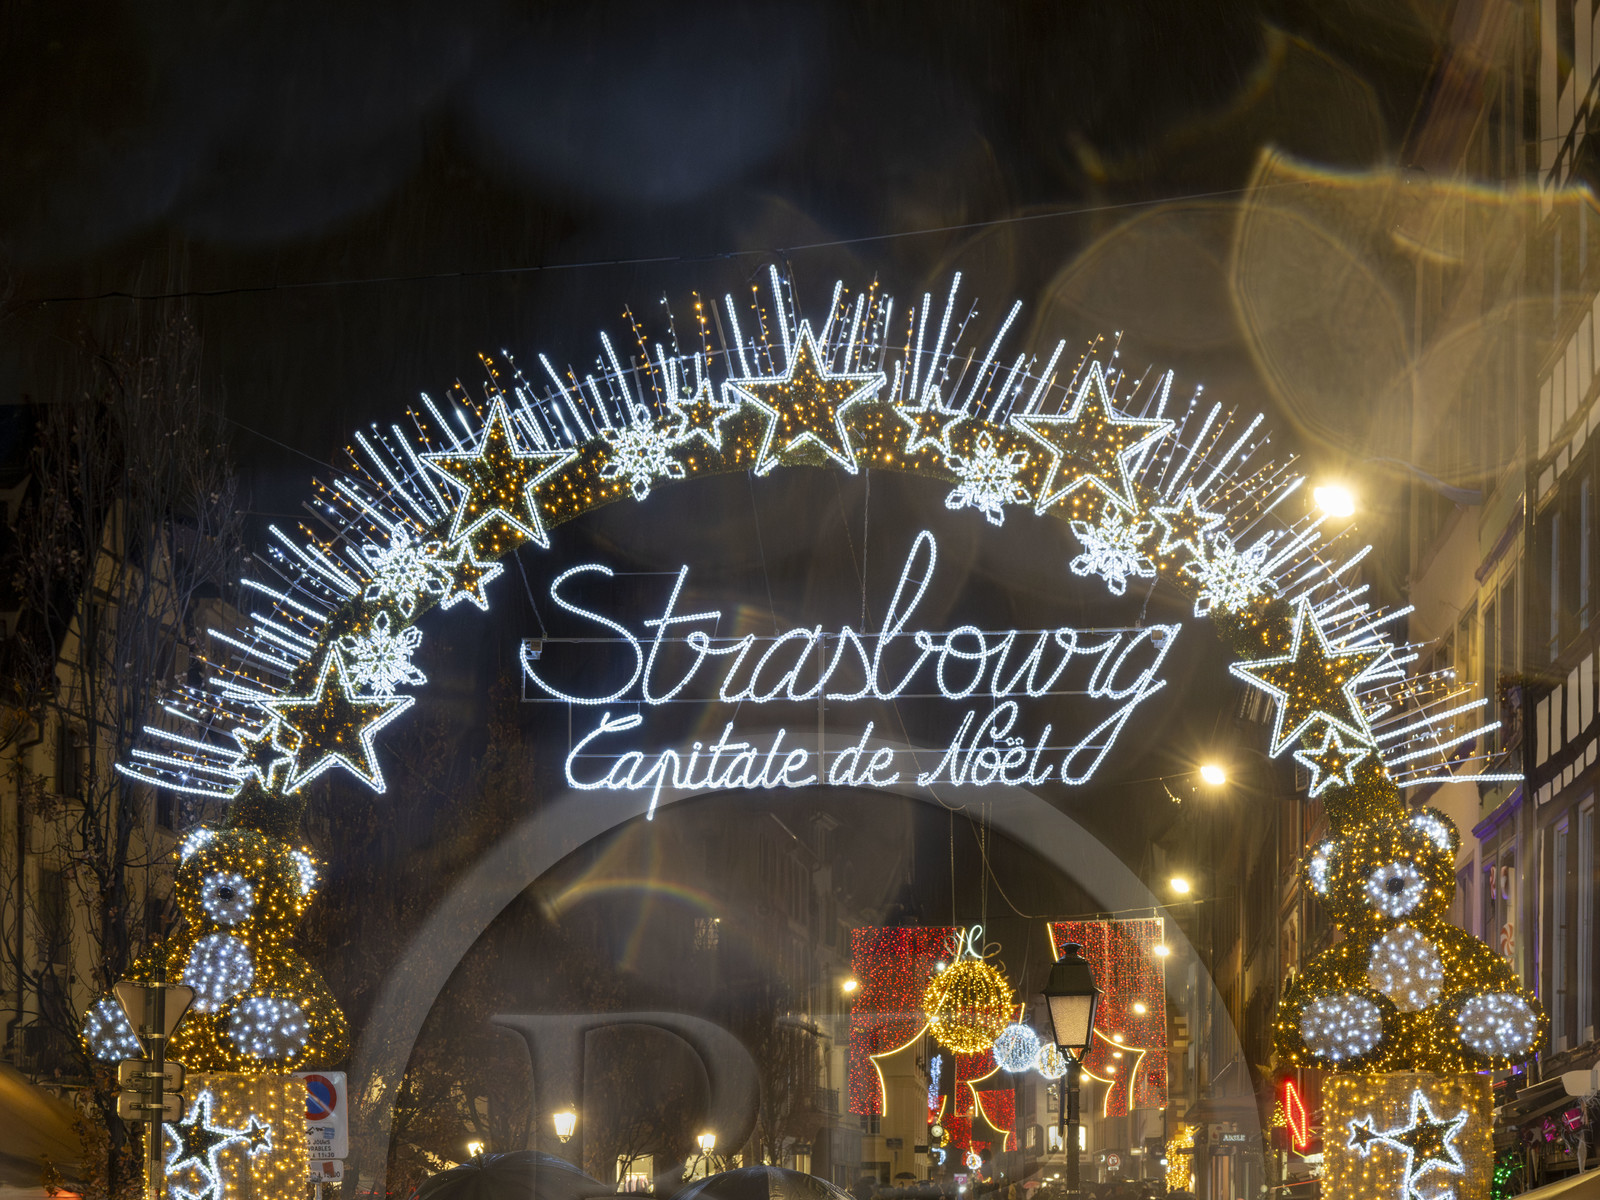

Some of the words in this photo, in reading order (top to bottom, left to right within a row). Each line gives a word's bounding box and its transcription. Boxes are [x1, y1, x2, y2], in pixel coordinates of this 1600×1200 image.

[519, 530, 1183, 787] Strasbourg
[564, 711, 817, 821] Capitale
[828, 720, 900, 788] de
[917, 700, 1055, 788] Noël
